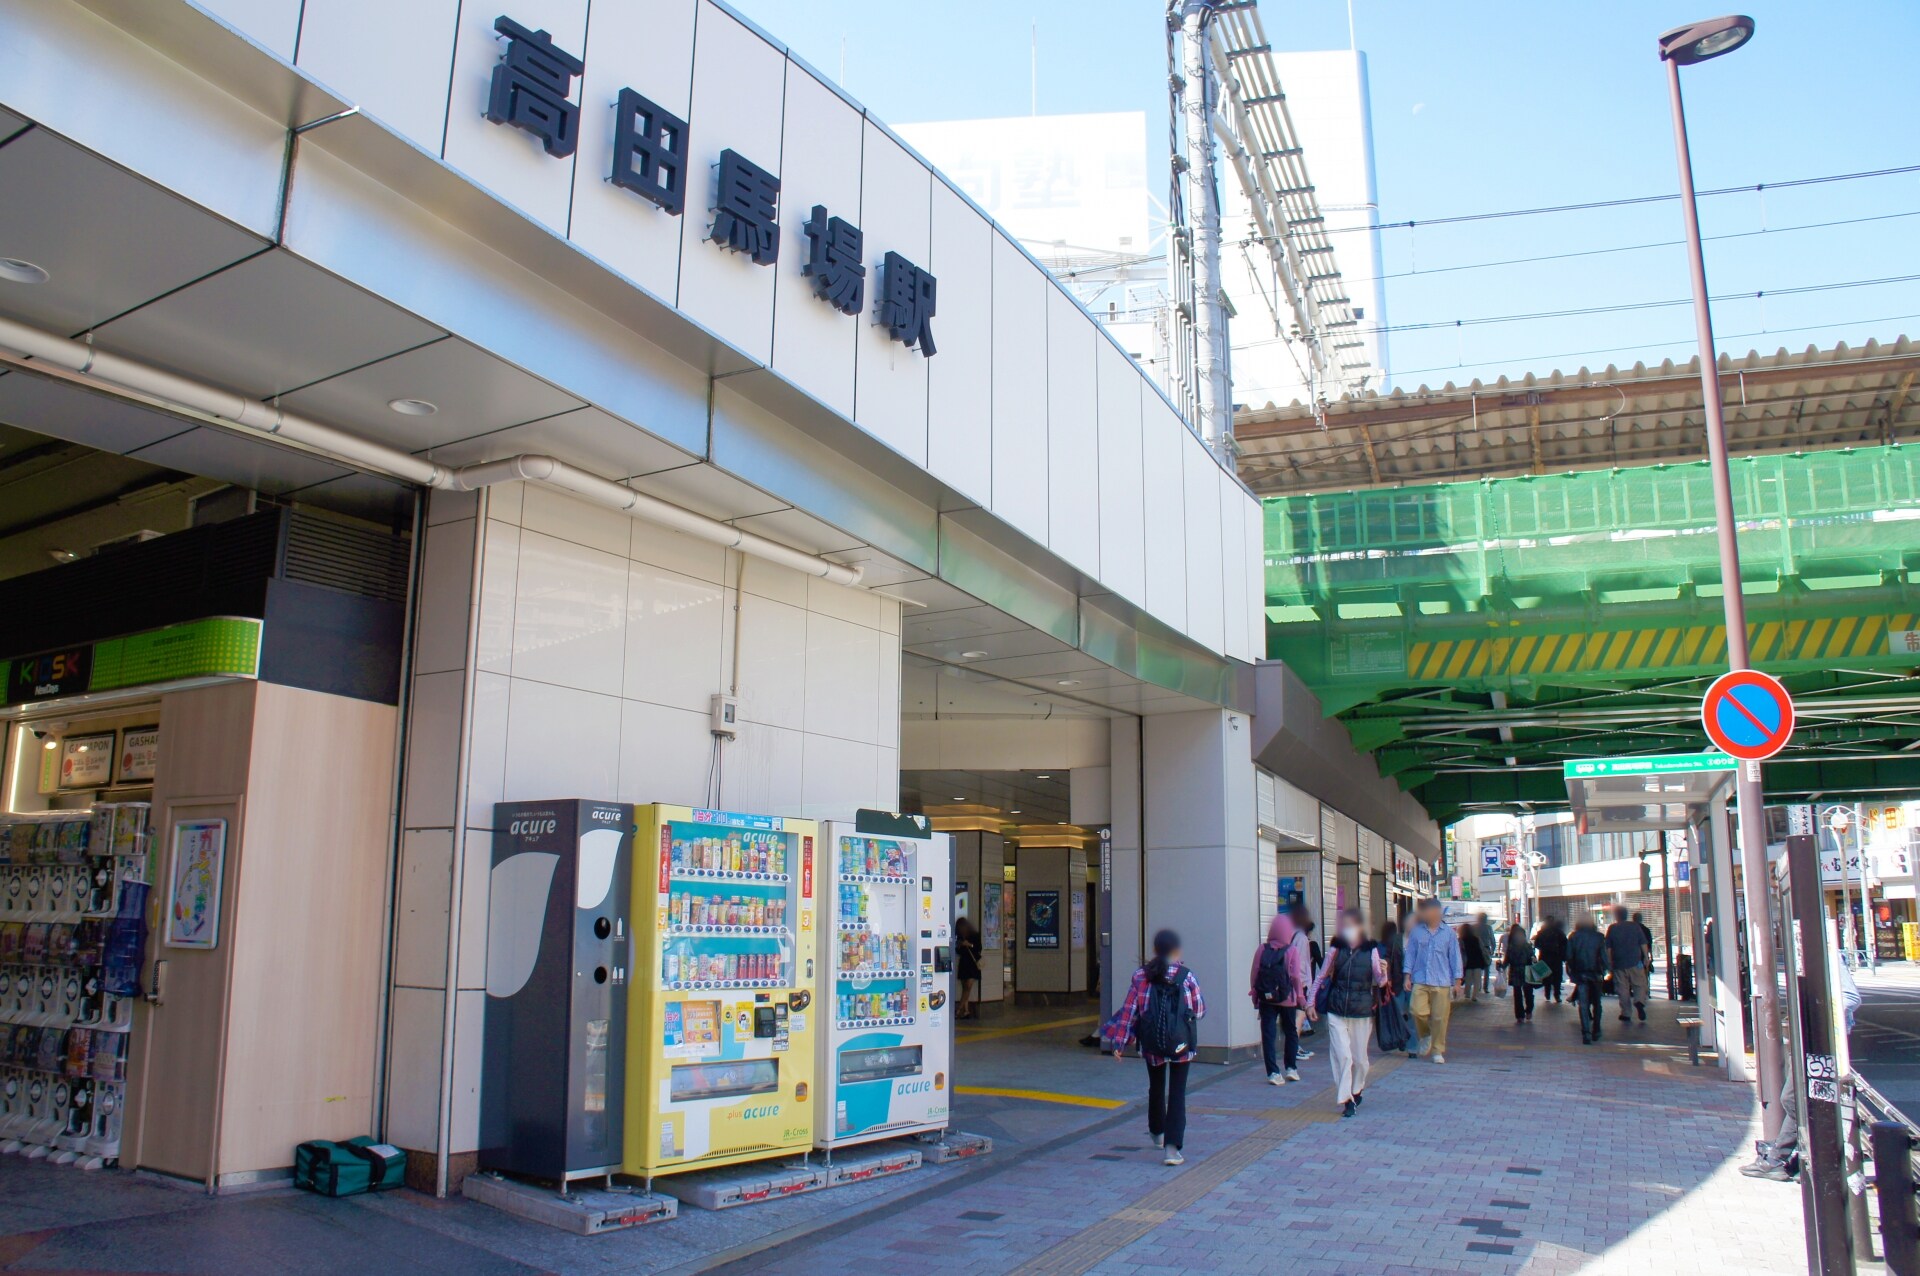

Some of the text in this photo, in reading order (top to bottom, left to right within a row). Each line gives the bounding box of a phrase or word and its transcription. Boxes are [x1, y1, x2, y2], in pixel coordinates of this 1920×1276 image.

[485, 15, 937, 358] 高田馬場駅
[19, 651, 80, 686] KIOSK
[591, 810, 622, 822] acure
[509, 819, 557, 836] acure
[742, 830, 779, 845] acure
[897, 1079, 931, 1096] acure
[743, 1103, 780, 1121] acure
[783, 1127, 809, 1138] JR-Cross
